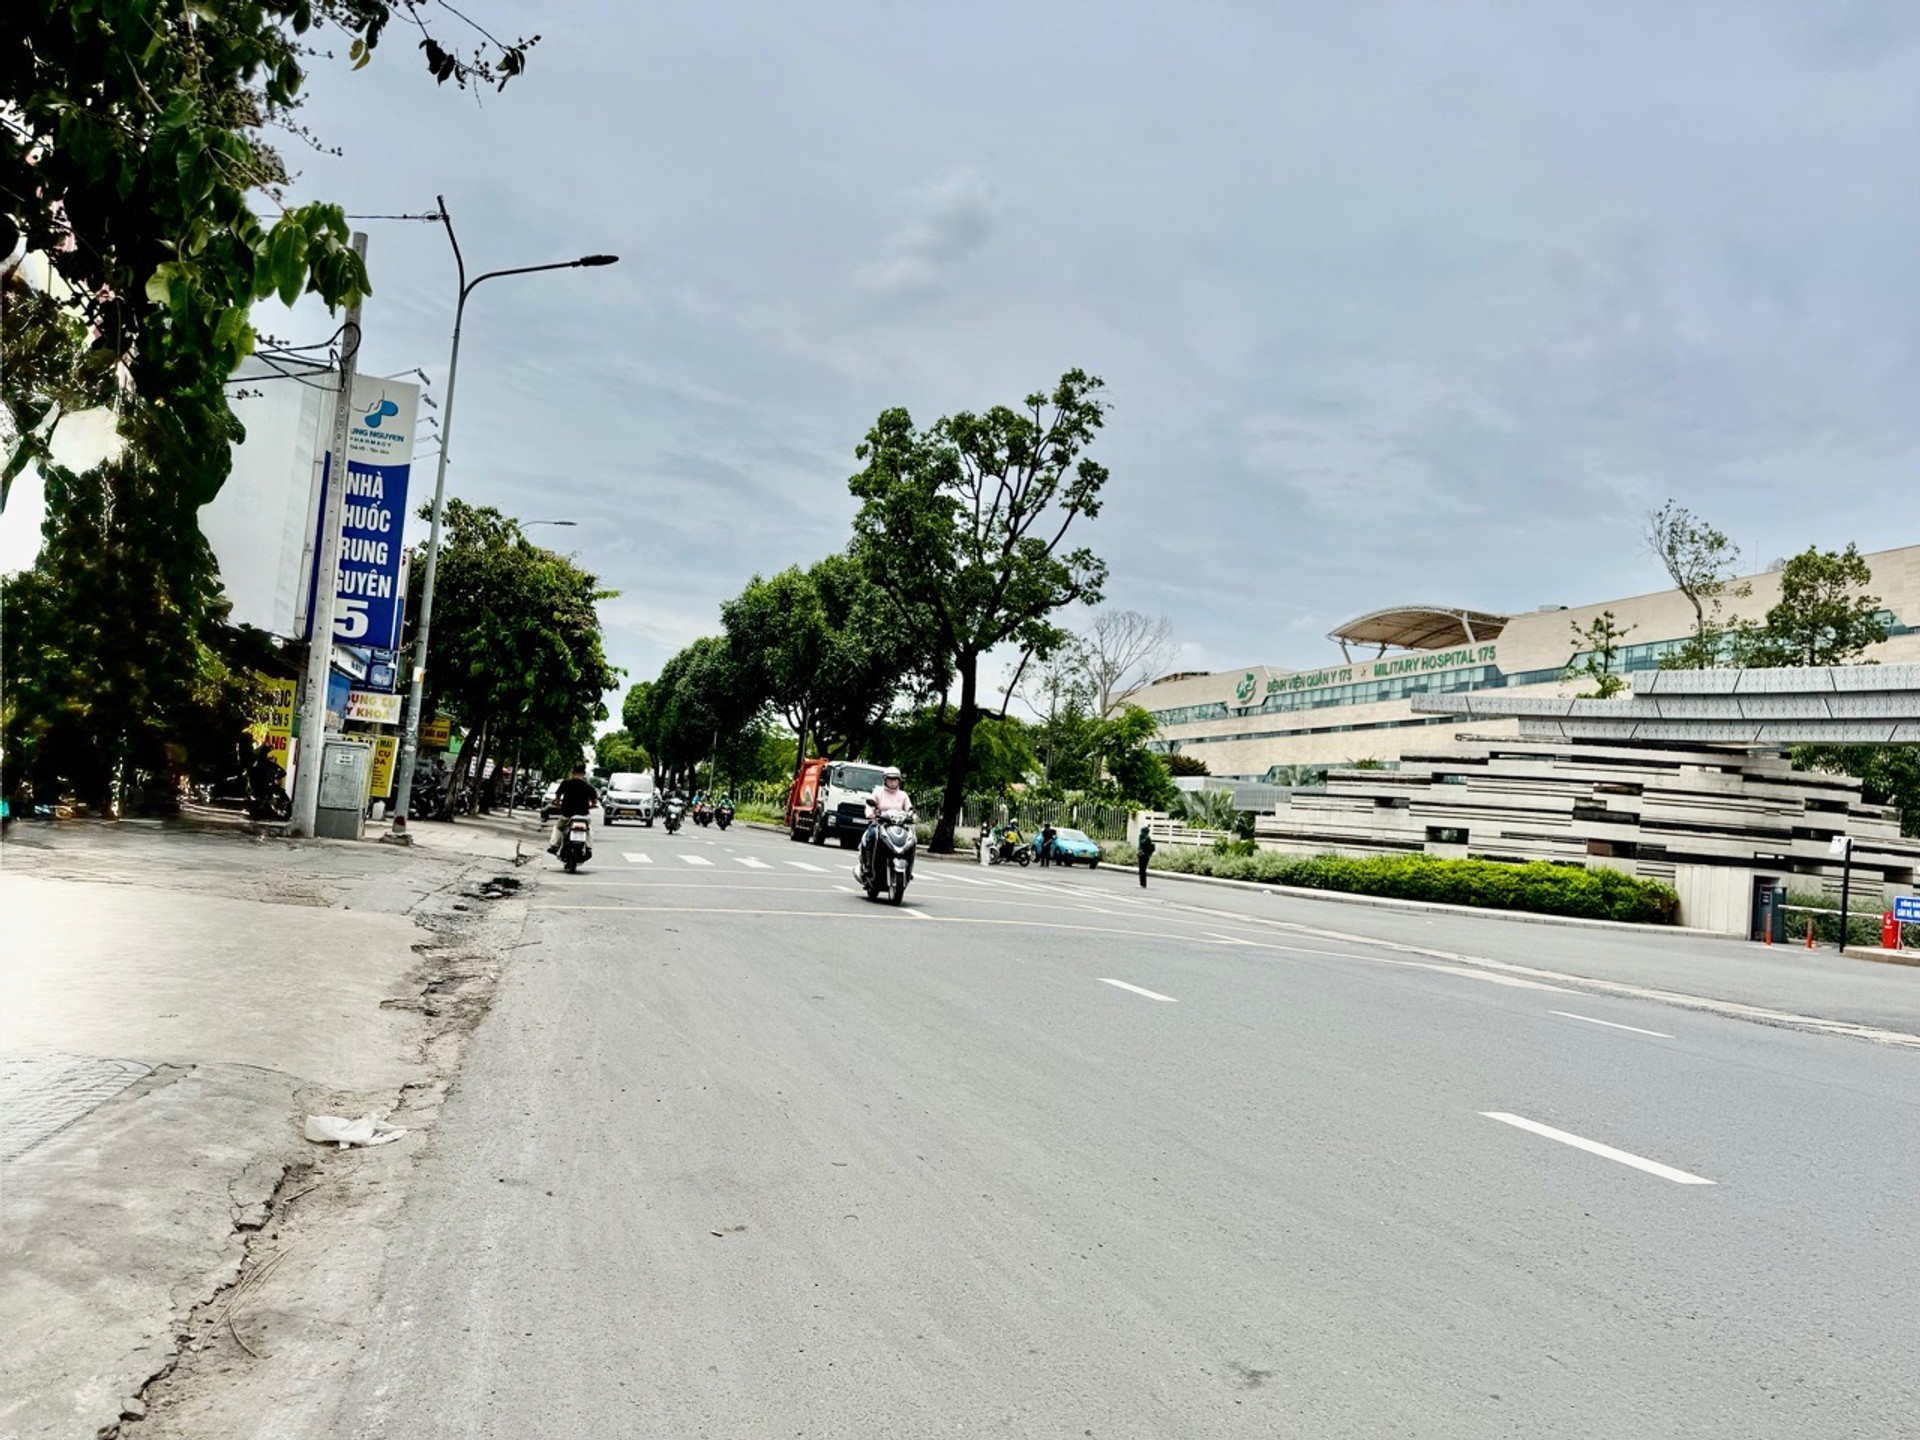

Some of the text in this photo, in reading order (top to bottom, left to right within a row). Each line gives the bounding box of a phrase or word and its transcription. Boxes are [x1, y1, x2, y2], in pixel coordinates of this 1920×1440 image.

[346, 471, 383, 499] NHÀ
[343, 501, 391, 533] HUỐC
[339, 536, 388, 566] RUNG
[336, 569, 392, 599] GUYÊN
[333, 599, 369, 638] 5
[1330, 670, 1337, 683] Y
[1339, 668, 1352, 682] 175
[1374, 645, 1496, 677] MILITARY HOSPITAL 175
